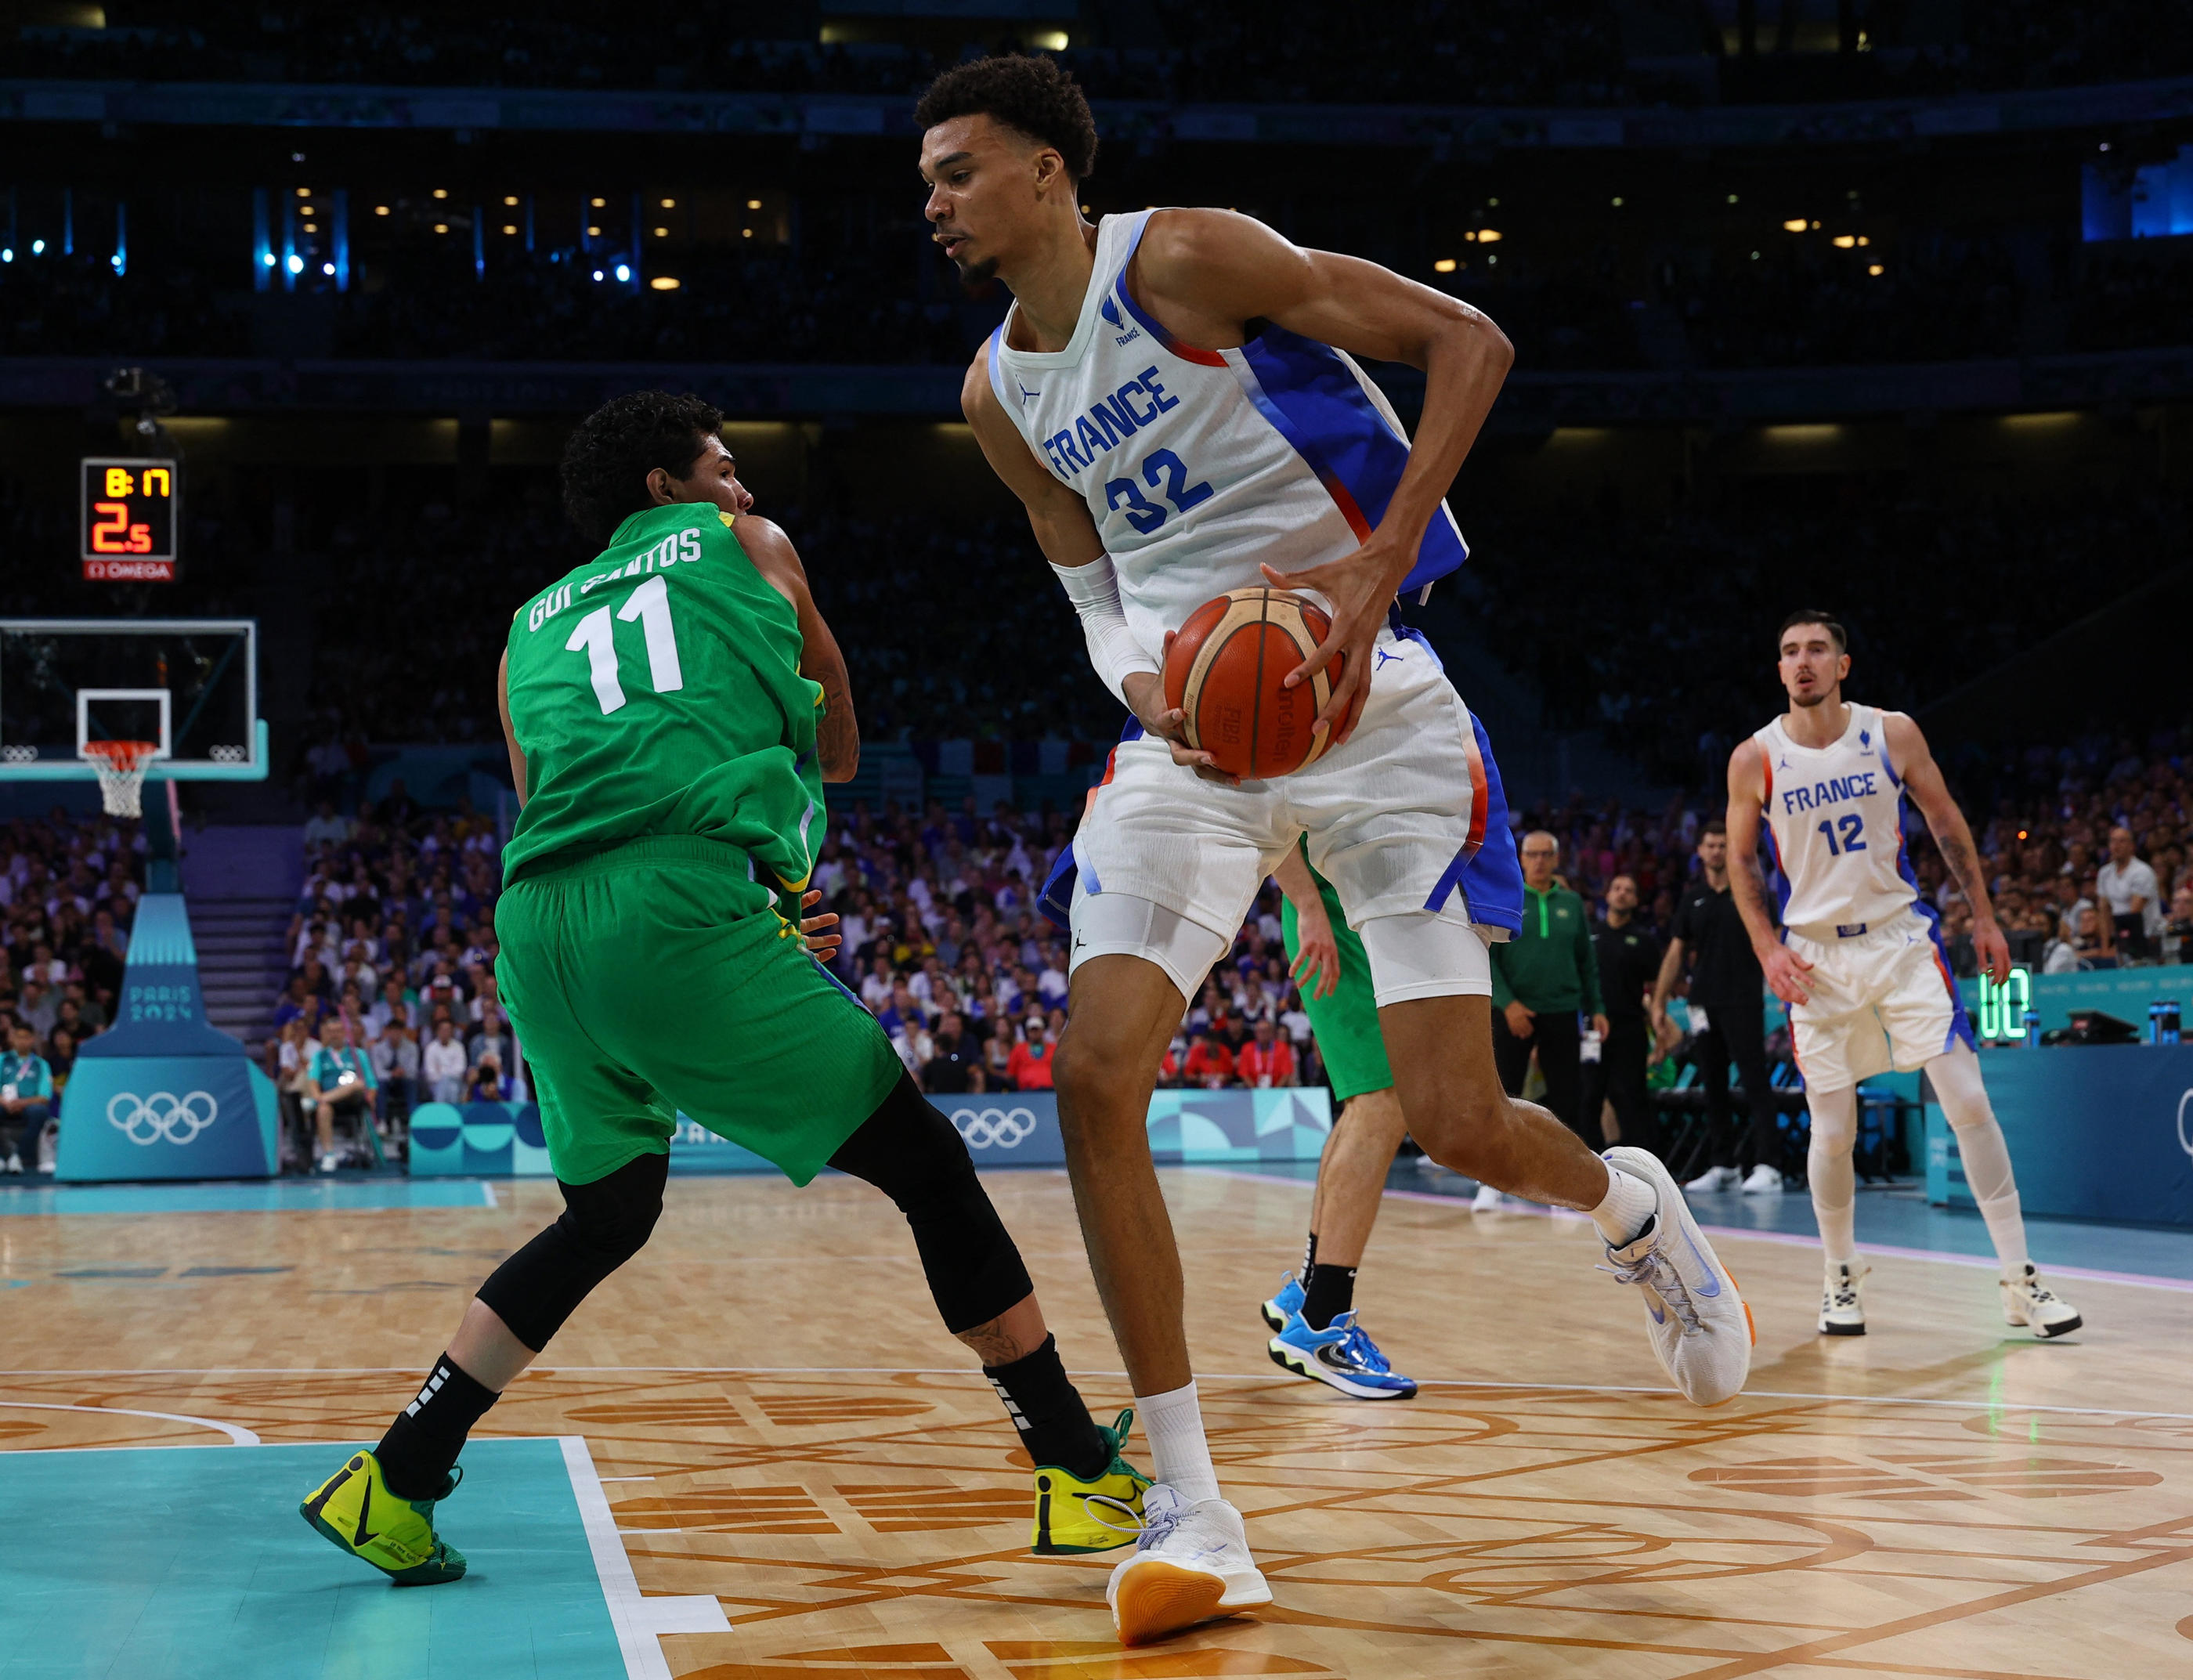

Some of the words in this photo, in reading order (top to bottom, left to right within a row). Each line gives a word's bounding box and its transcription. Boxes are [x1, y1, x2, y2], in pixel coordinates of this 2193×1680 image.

[1115, 327, 1140, 347] FRANCE
[1043, 365, 1180, 480] FRANCE
[106, 468, 169, 497] 8:17
[1104, 449, 1215, 535] 32
[92, 502, 152, 553] 2.5
[107, 562, 170, 579] OMEGA
[529, 582, 573, 633] GUI
[580, 527, 701, 594] SANTOS
[565, 575, 684, 716] 11
[1277, 687, 1295, 762] molten
[1783, 772, 1877, 815] FRANCE
[1818, 814, 1866, 855] 12
[130, 1003, 192, 1021] 2024
